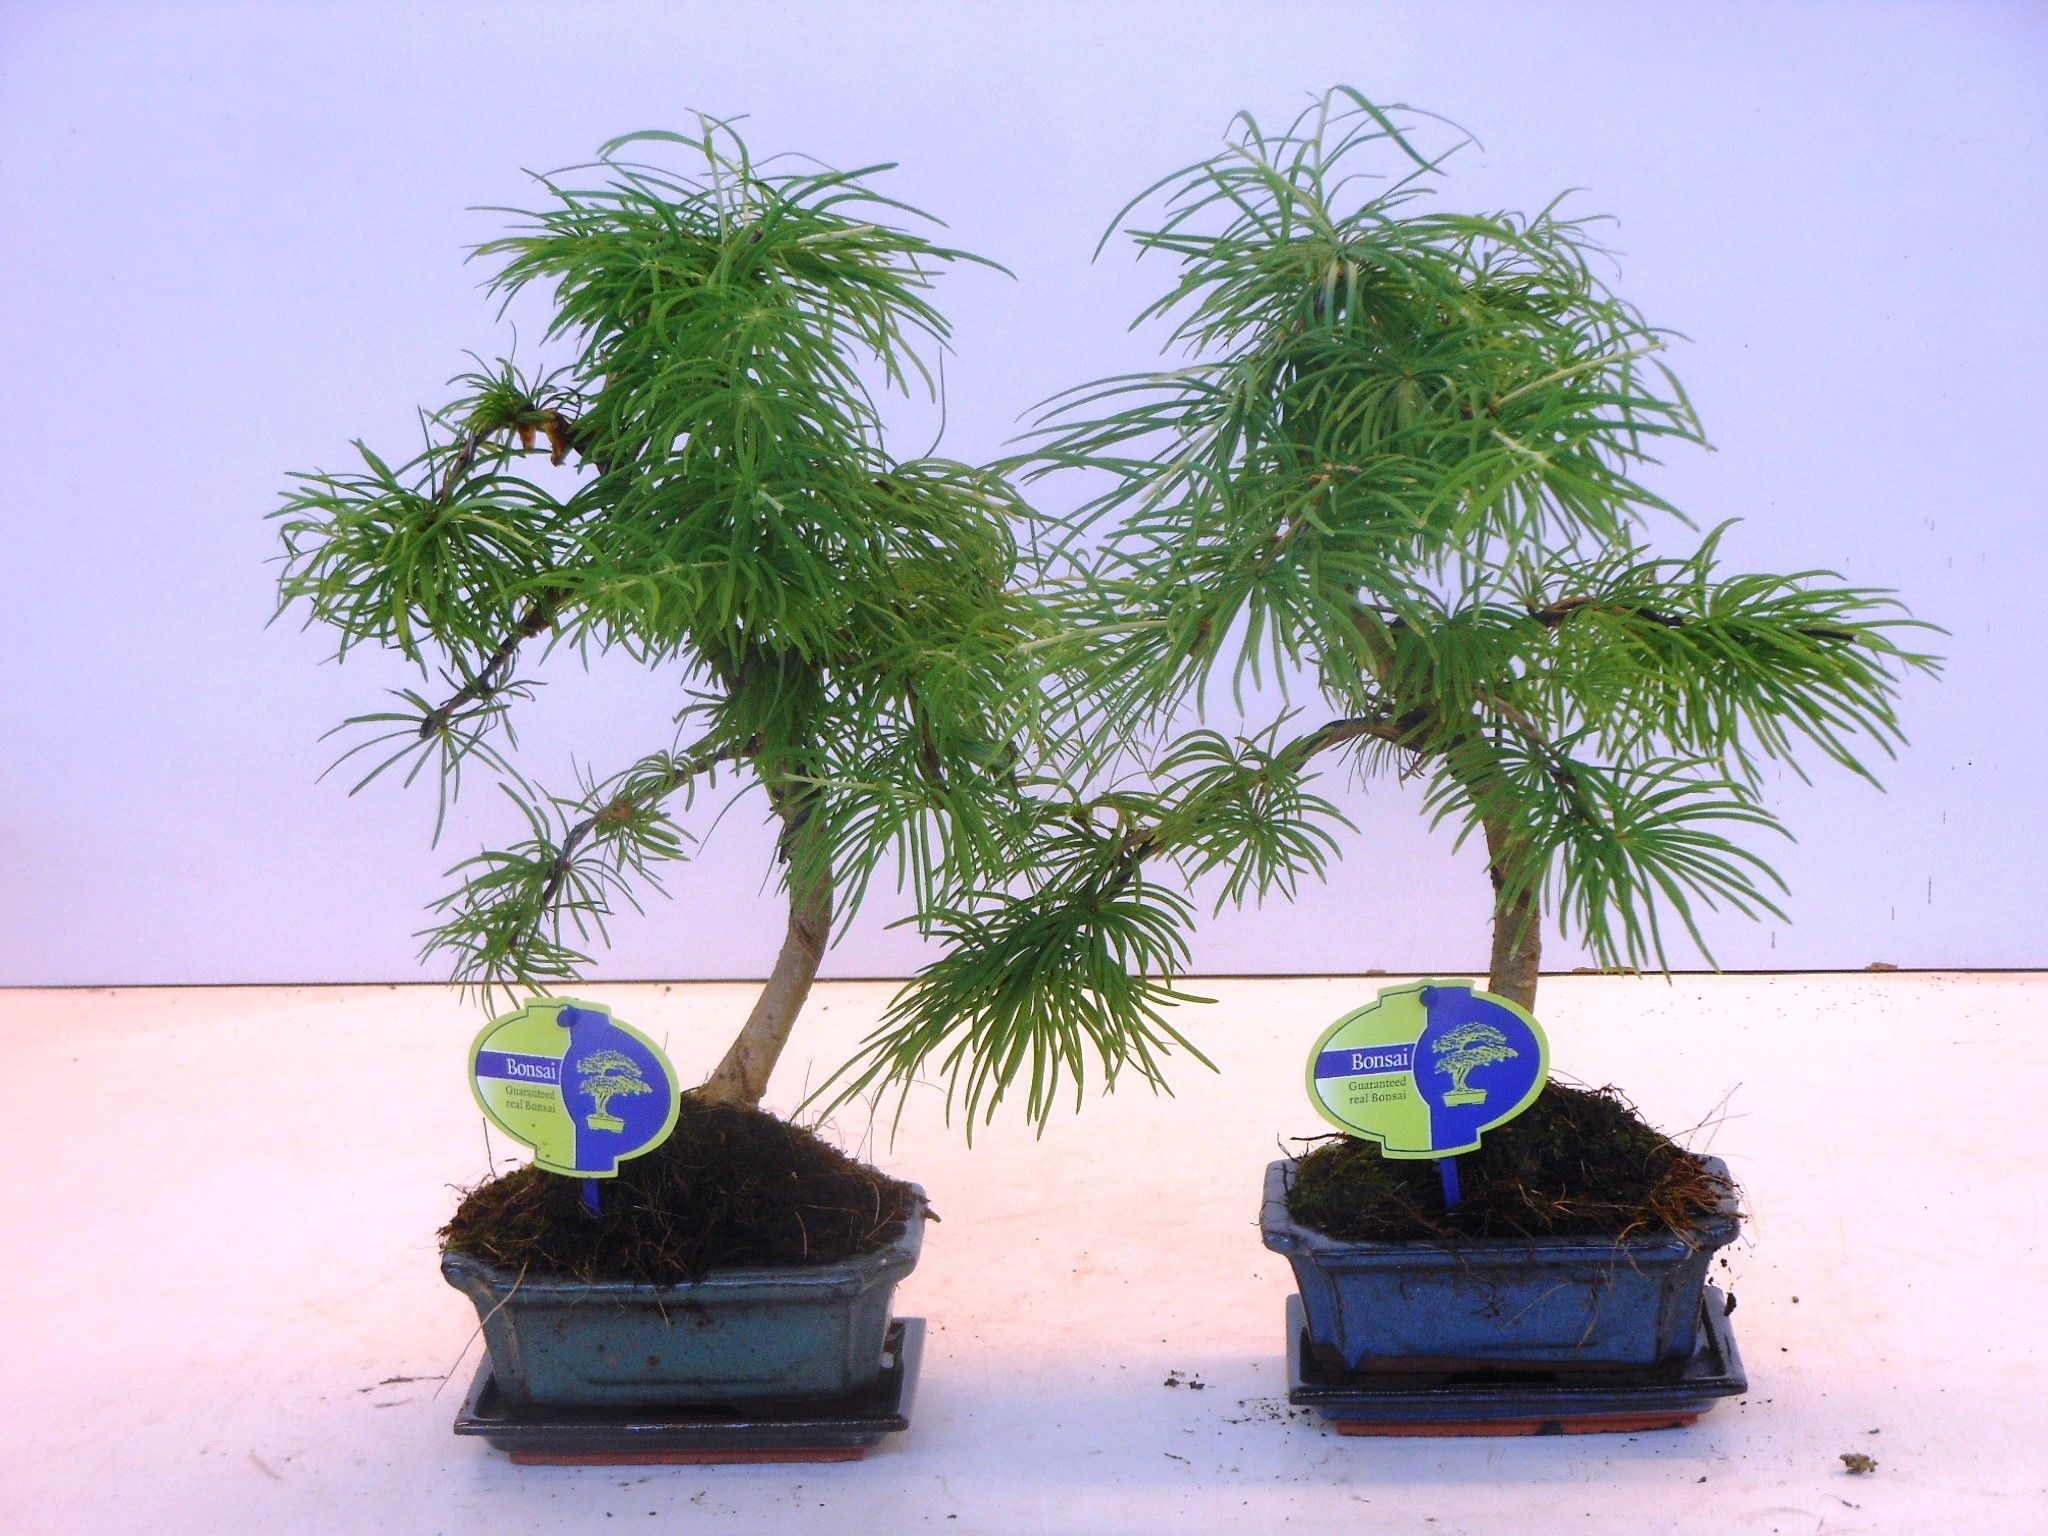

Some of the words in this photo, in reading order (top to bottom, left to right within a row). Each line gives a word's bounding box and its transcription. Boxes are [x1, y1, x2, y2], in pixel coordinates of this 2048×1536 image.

[1351, 1047, 1409, 1071] Bonsai
[506, 1058, 557, 1080] Bonsai
[1348, 1076, 1407, 1091] Guaranteed
[505, 1085, 555, 1100] Guaranteed
[1349, 1093, 1369, 1104] real
[1371, 1090, 1407, 1103] Bonsai
[506, 1099, 523, 1110] real
[525, 1101, 556, 1113] Bonsai
